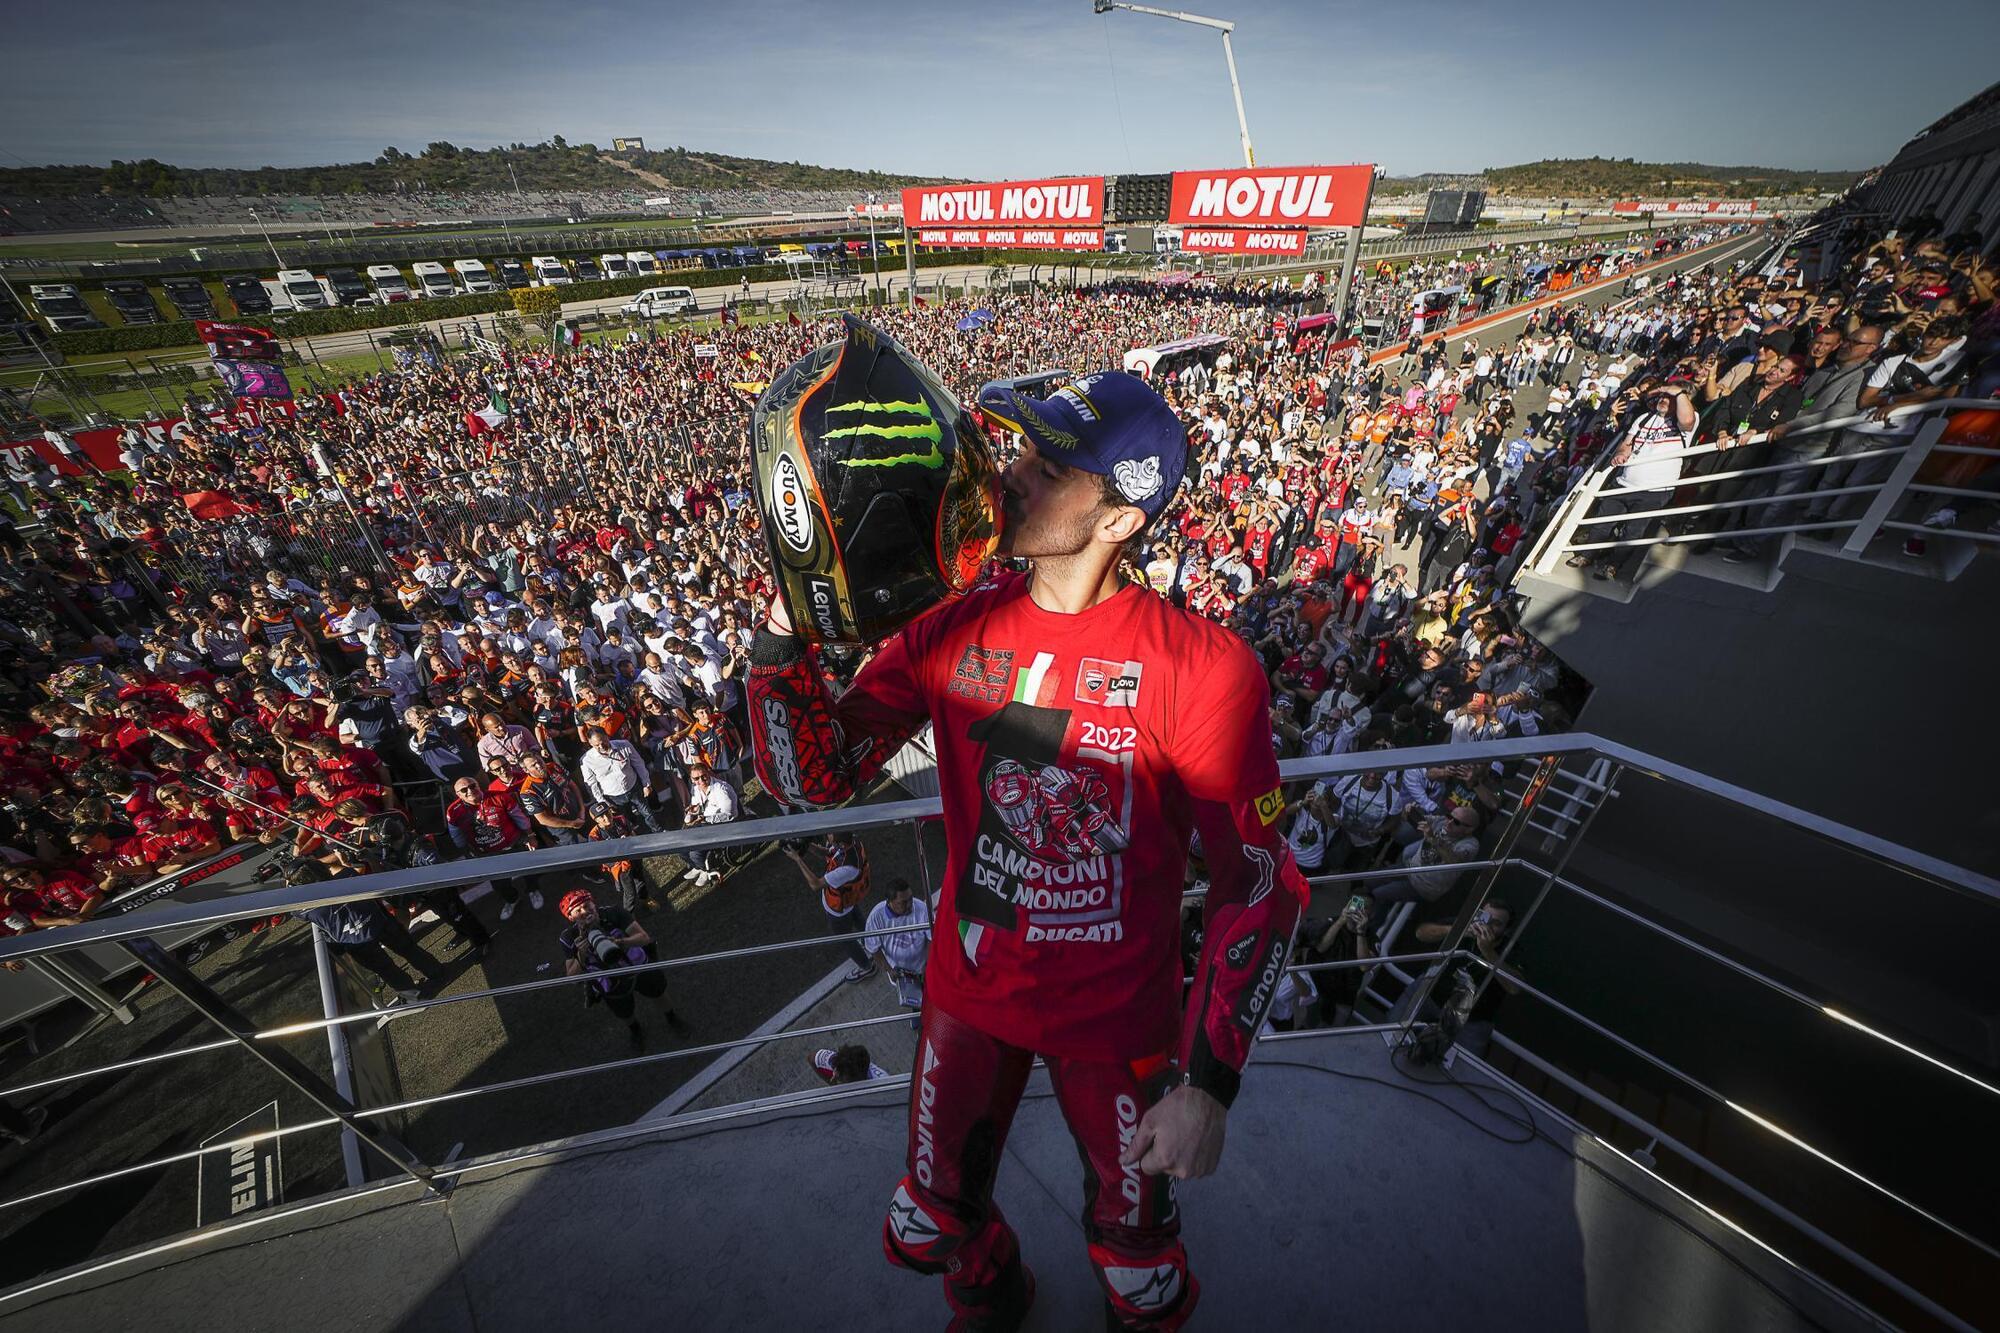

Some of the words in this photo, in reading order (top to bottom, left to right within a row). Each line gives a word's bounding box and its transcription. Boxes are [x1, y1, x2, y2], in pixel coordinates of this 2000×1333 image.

[920, 189, 995, 222] MOTUL
[1000, 184, 1093, 220] MOTUL
[1189, 174, 1334, 218] MOTUL
[1637, 202, 1669, 211] MOTUL
[1675, 202, 1710, 211] MOTUL
[1716, 202, 1752, 211] MOTUL
[921, 230, 948, 243] MOTUL
[952, 231, 981, 244] MOTUL
[986, 231, 1017, 244] MOTUL
[1022, 231, 1056, 244] MOTUL
[1062, 231, 1099, 245] MOTUL
[1186, 231, 1236, 248] MOTUL
[1245, 232, 1299, 250] MOTUL
[782, 464, 801, 542] SUOMY
[810, 579, 838, 640] Lenovo
[954, 643, 1016, 688] 63
[1080, 721, 1138, 751] 2022
[180, 854, 243, 888] PREMIER
[977, 834, 1108, 886] CAMPIONI
[973, 863, 1008, 900] DEL
[1011, 885, 1106, 911] MONDO
[1025, 920, 1124, 943] DUCATI
[1240, 941, 1284, 1028] Lenovo
[916, 1076, 937, 1188] DAIKO
[1115, 1095, 1141, 1205] DAKO
